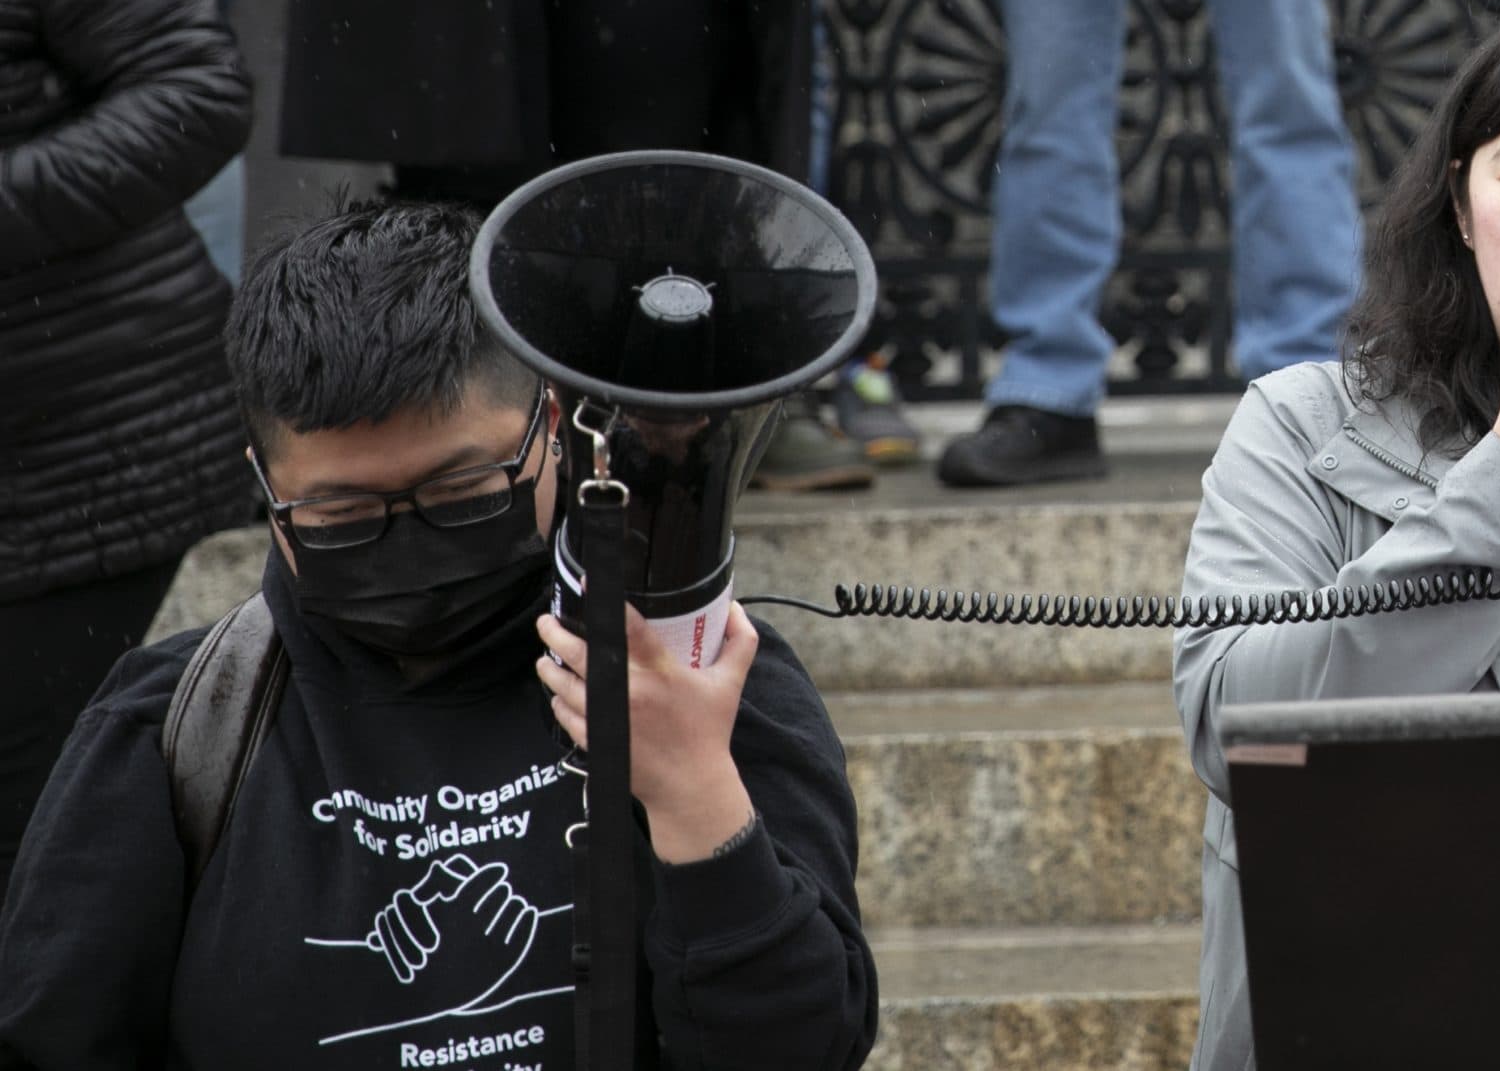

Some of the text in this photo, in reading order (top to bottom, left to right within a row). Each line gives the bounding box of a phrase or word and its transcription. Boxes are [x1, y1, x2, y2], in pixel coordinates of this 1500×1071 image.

[312, 789, 428, 824] Cmmunity
[353, 810, 530, 859] for Solidarity
[400, 1025, 545, 1068] Resistance
